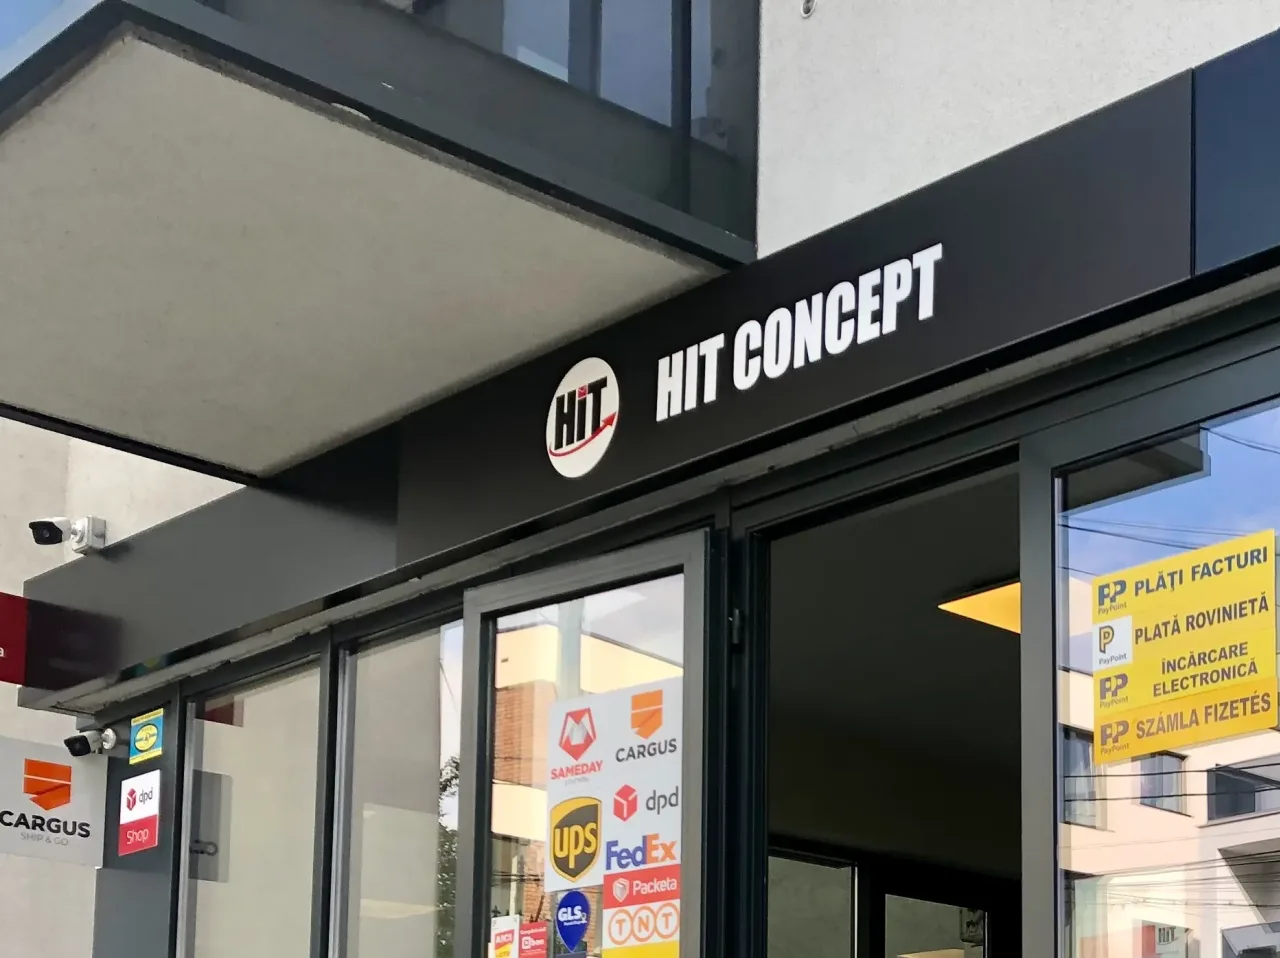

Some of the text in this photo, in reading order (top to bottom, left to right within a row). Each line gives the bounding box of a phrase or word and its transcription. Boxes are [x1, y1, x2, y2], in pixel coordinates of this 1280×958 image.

[656, 243, 943, 422] HIT CONCEPT
[1191, 546, 1268, 582] FACTURI
[1098, 601, 1127, 615] PayPoint
[1134, 592, 1269, 645] PLATĂ ROVINIETĂ
[1099, 653, 1127, 665] PayPoint
[1161, 641, 1248, 675] ÎNCĂRCARE
[1153, 657, 1258, 698] ELECTRONICĂ
[1099, 695, 1128, 709] PayPoint
[1136, 691, 1271, 740] SZÁMLA FIZETÉS
[615, 738, 677, 763] CARGUS
[1100, 742, 1129, 755] PayPoint
[550, 760, 603, 780] SAMEDAY
[138, 786, 154, 804] dpd
[645, 785, 679, 815] dpd
[0, 809, 91, 838] CARGUS
[20, 832, 44, 842] SHIP
[53, 837, 69, 846] GO
[126, 828, 149, 845] Shop
[605, 833, 677, 870] FedEx
[632, 877, 677, 896] Packeta
[557, 905, 582, 921] GLS
[612, 908, 677, 941] TNT
